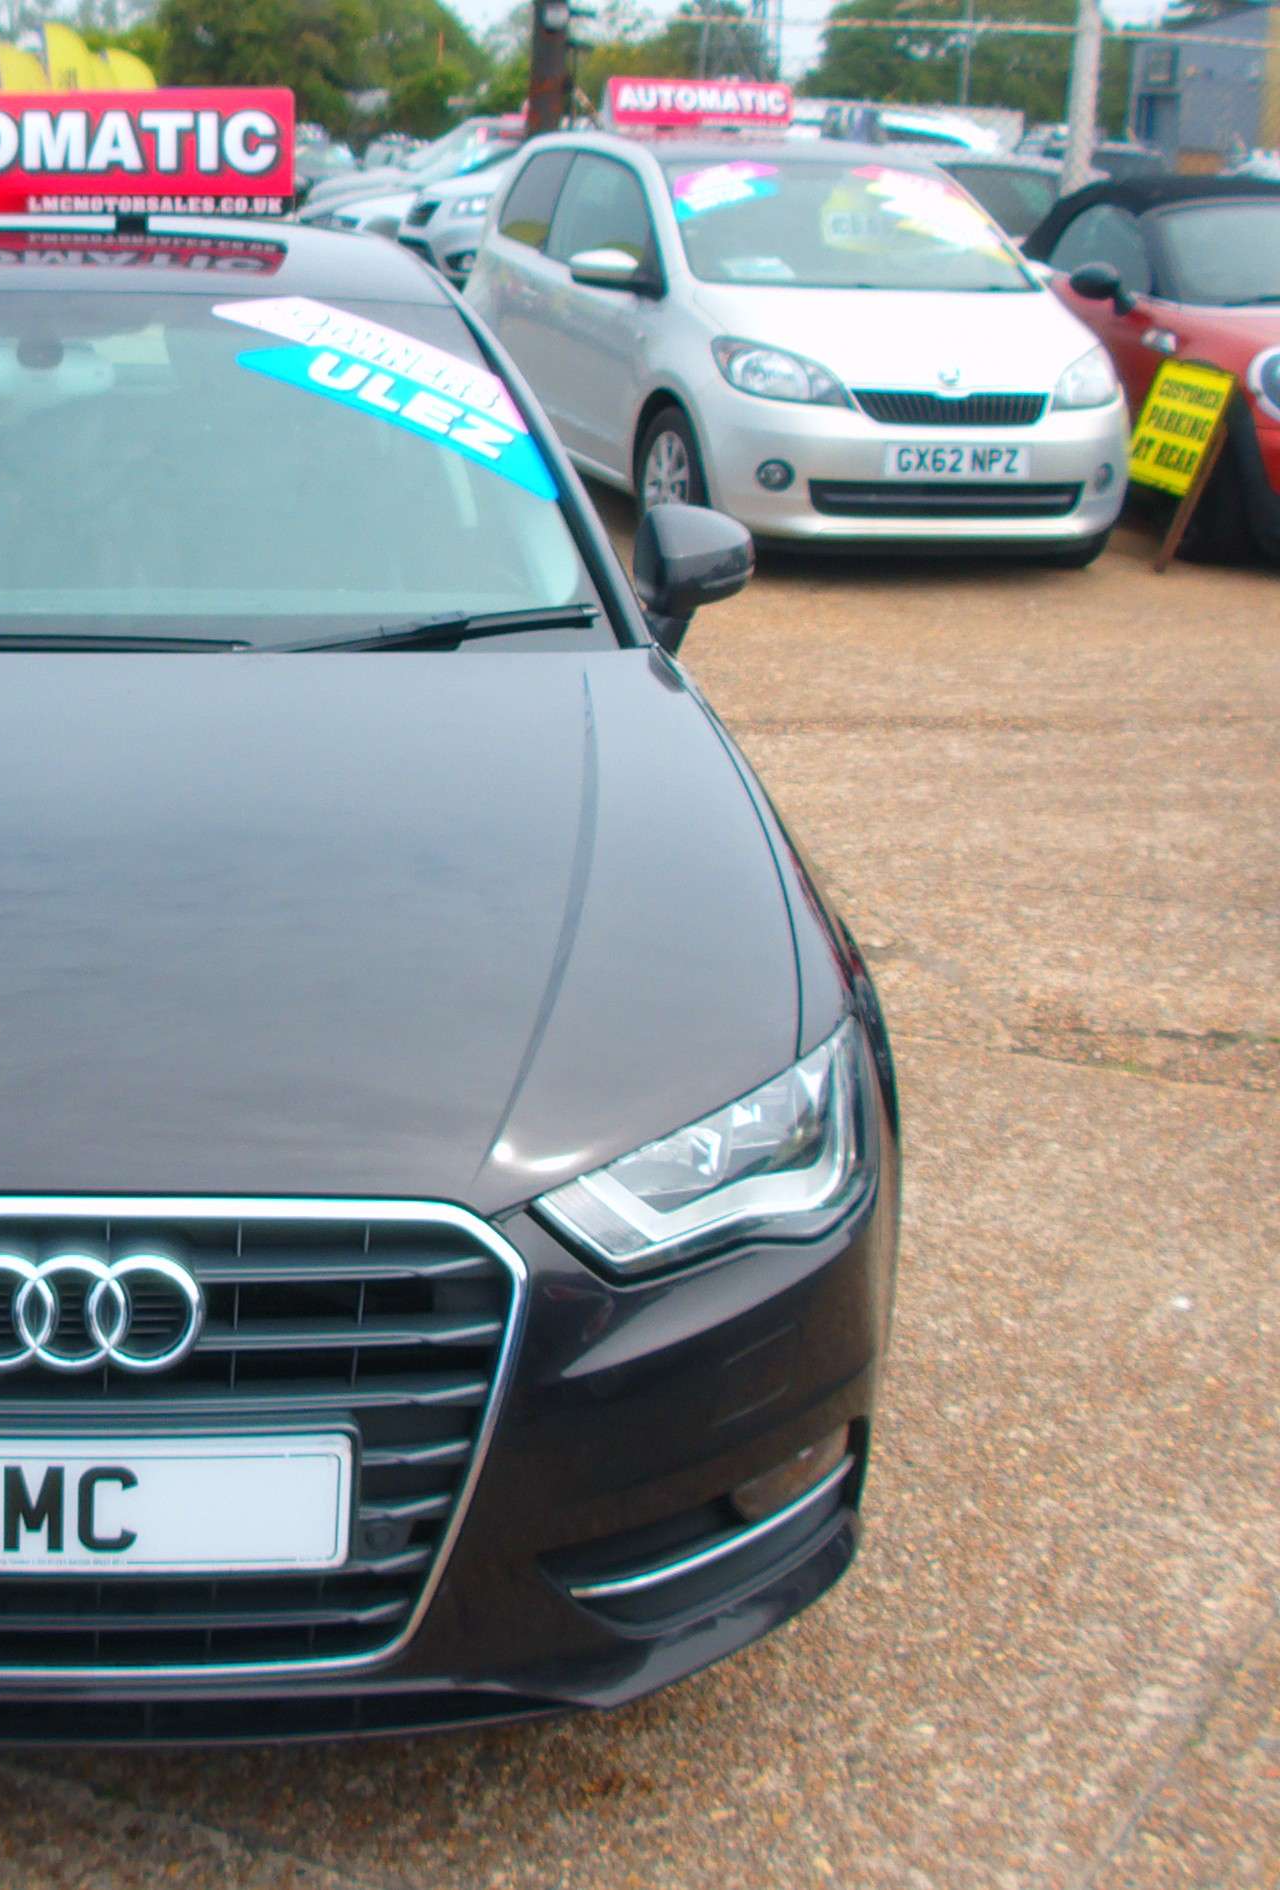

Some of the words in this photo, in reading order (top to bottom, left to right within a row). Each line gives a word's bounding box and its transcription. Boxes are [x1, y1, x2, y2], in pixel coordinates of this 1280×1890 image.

[618, 84, 787, 115] AUTOMATIC
[27, 195, 283, 214] LMCMOTORSALES.CO.UK
[307, 351, 514, 461] ULEZ
[1146, 404, 1213, 441] PARKING
[896, 447, 964, 473] GX62
[970, 447, 1020, 473] NPZ
[1132, 436, 1155, 461] AT
[1154, 442, 1199, 474] REAR
